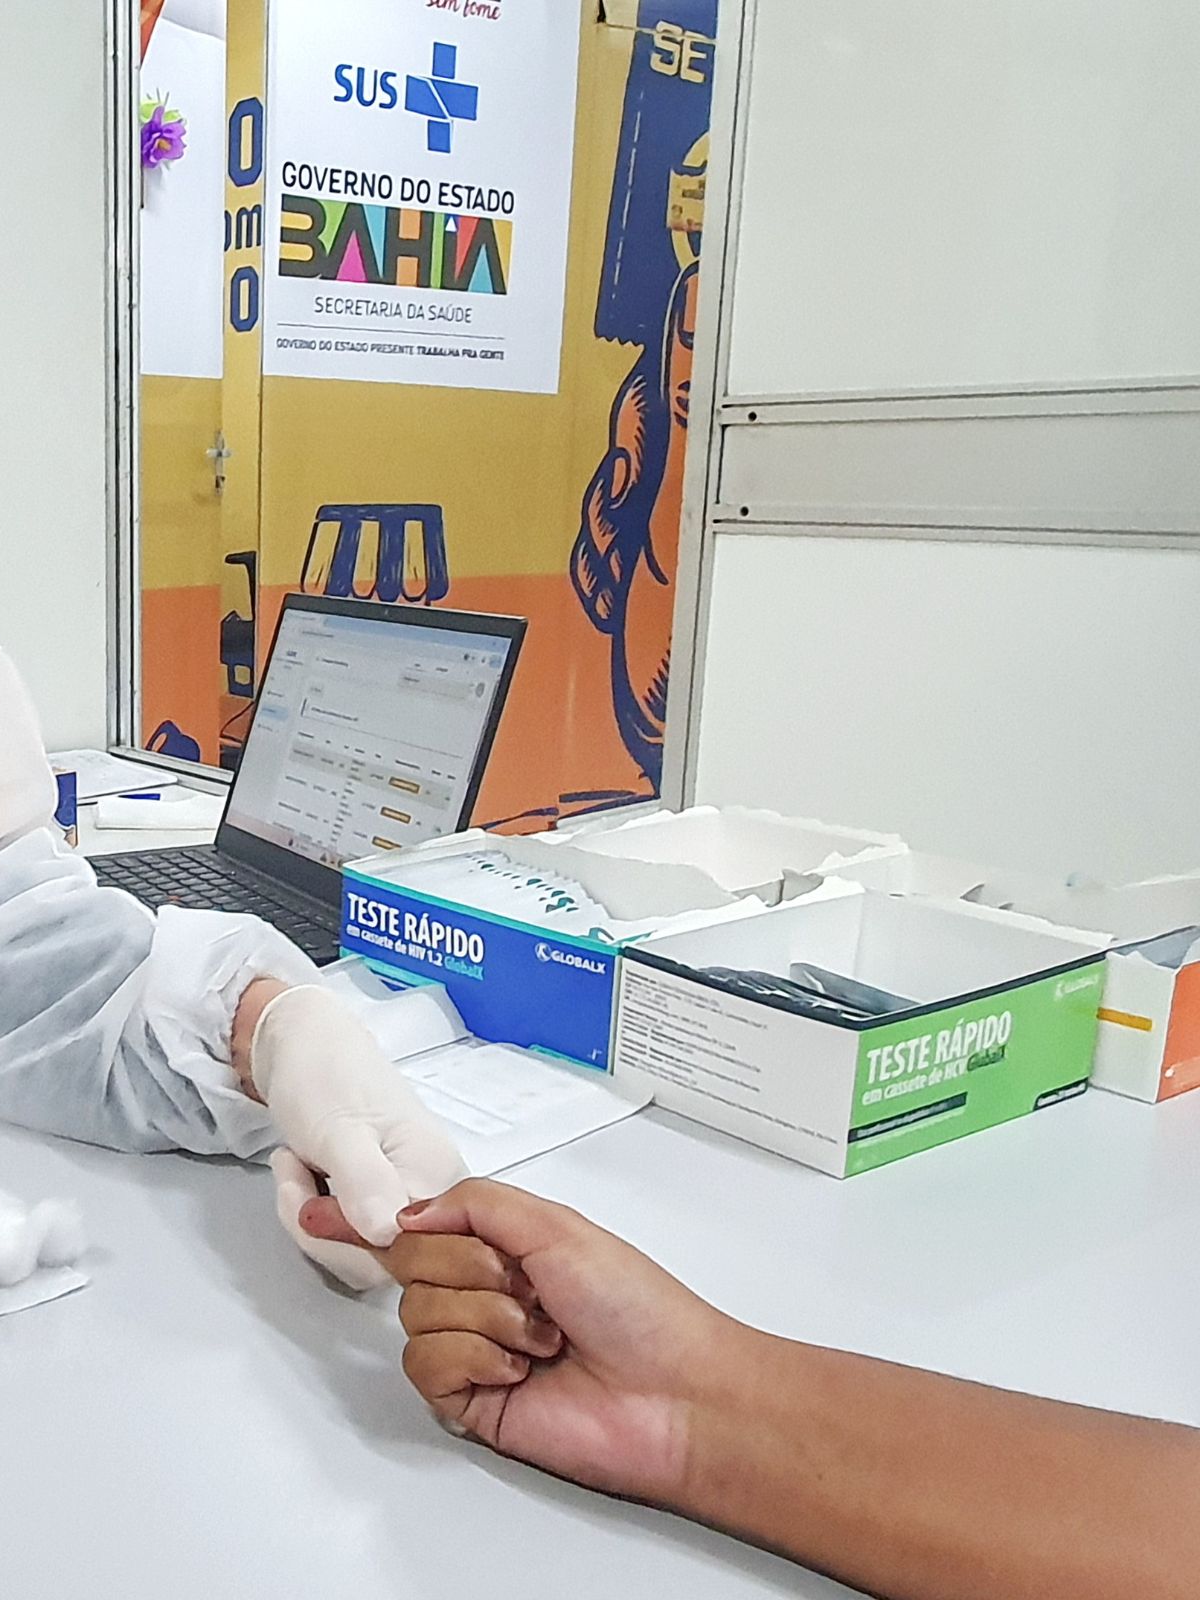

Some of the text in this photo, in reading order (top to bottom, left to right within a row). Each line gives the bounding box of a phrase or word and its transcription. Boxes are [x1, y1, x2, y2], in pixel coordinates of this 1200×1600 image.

[333, 63, 398, 110] SUS
[282, 161, 515, 214] GOVERNO DO ESTADO
[278, 193, 513, 296] BAHIA
[314, 297, 472, 324] SECRETARIA DA SAÚDE
[346, 924, 360, 938] em
[360, 928, 394, 950] cassete
[394, 938, 408, 955] de
[407, 942, 427, 961] HIV
[347, 892, 485, 964] TESTE RÁPIDO
[551, 950, 606, 975] GLOBALX
[867, 1010, 1013, 1084] TESTE RÁPIDO
[927, 1067, 944, 1086] de
